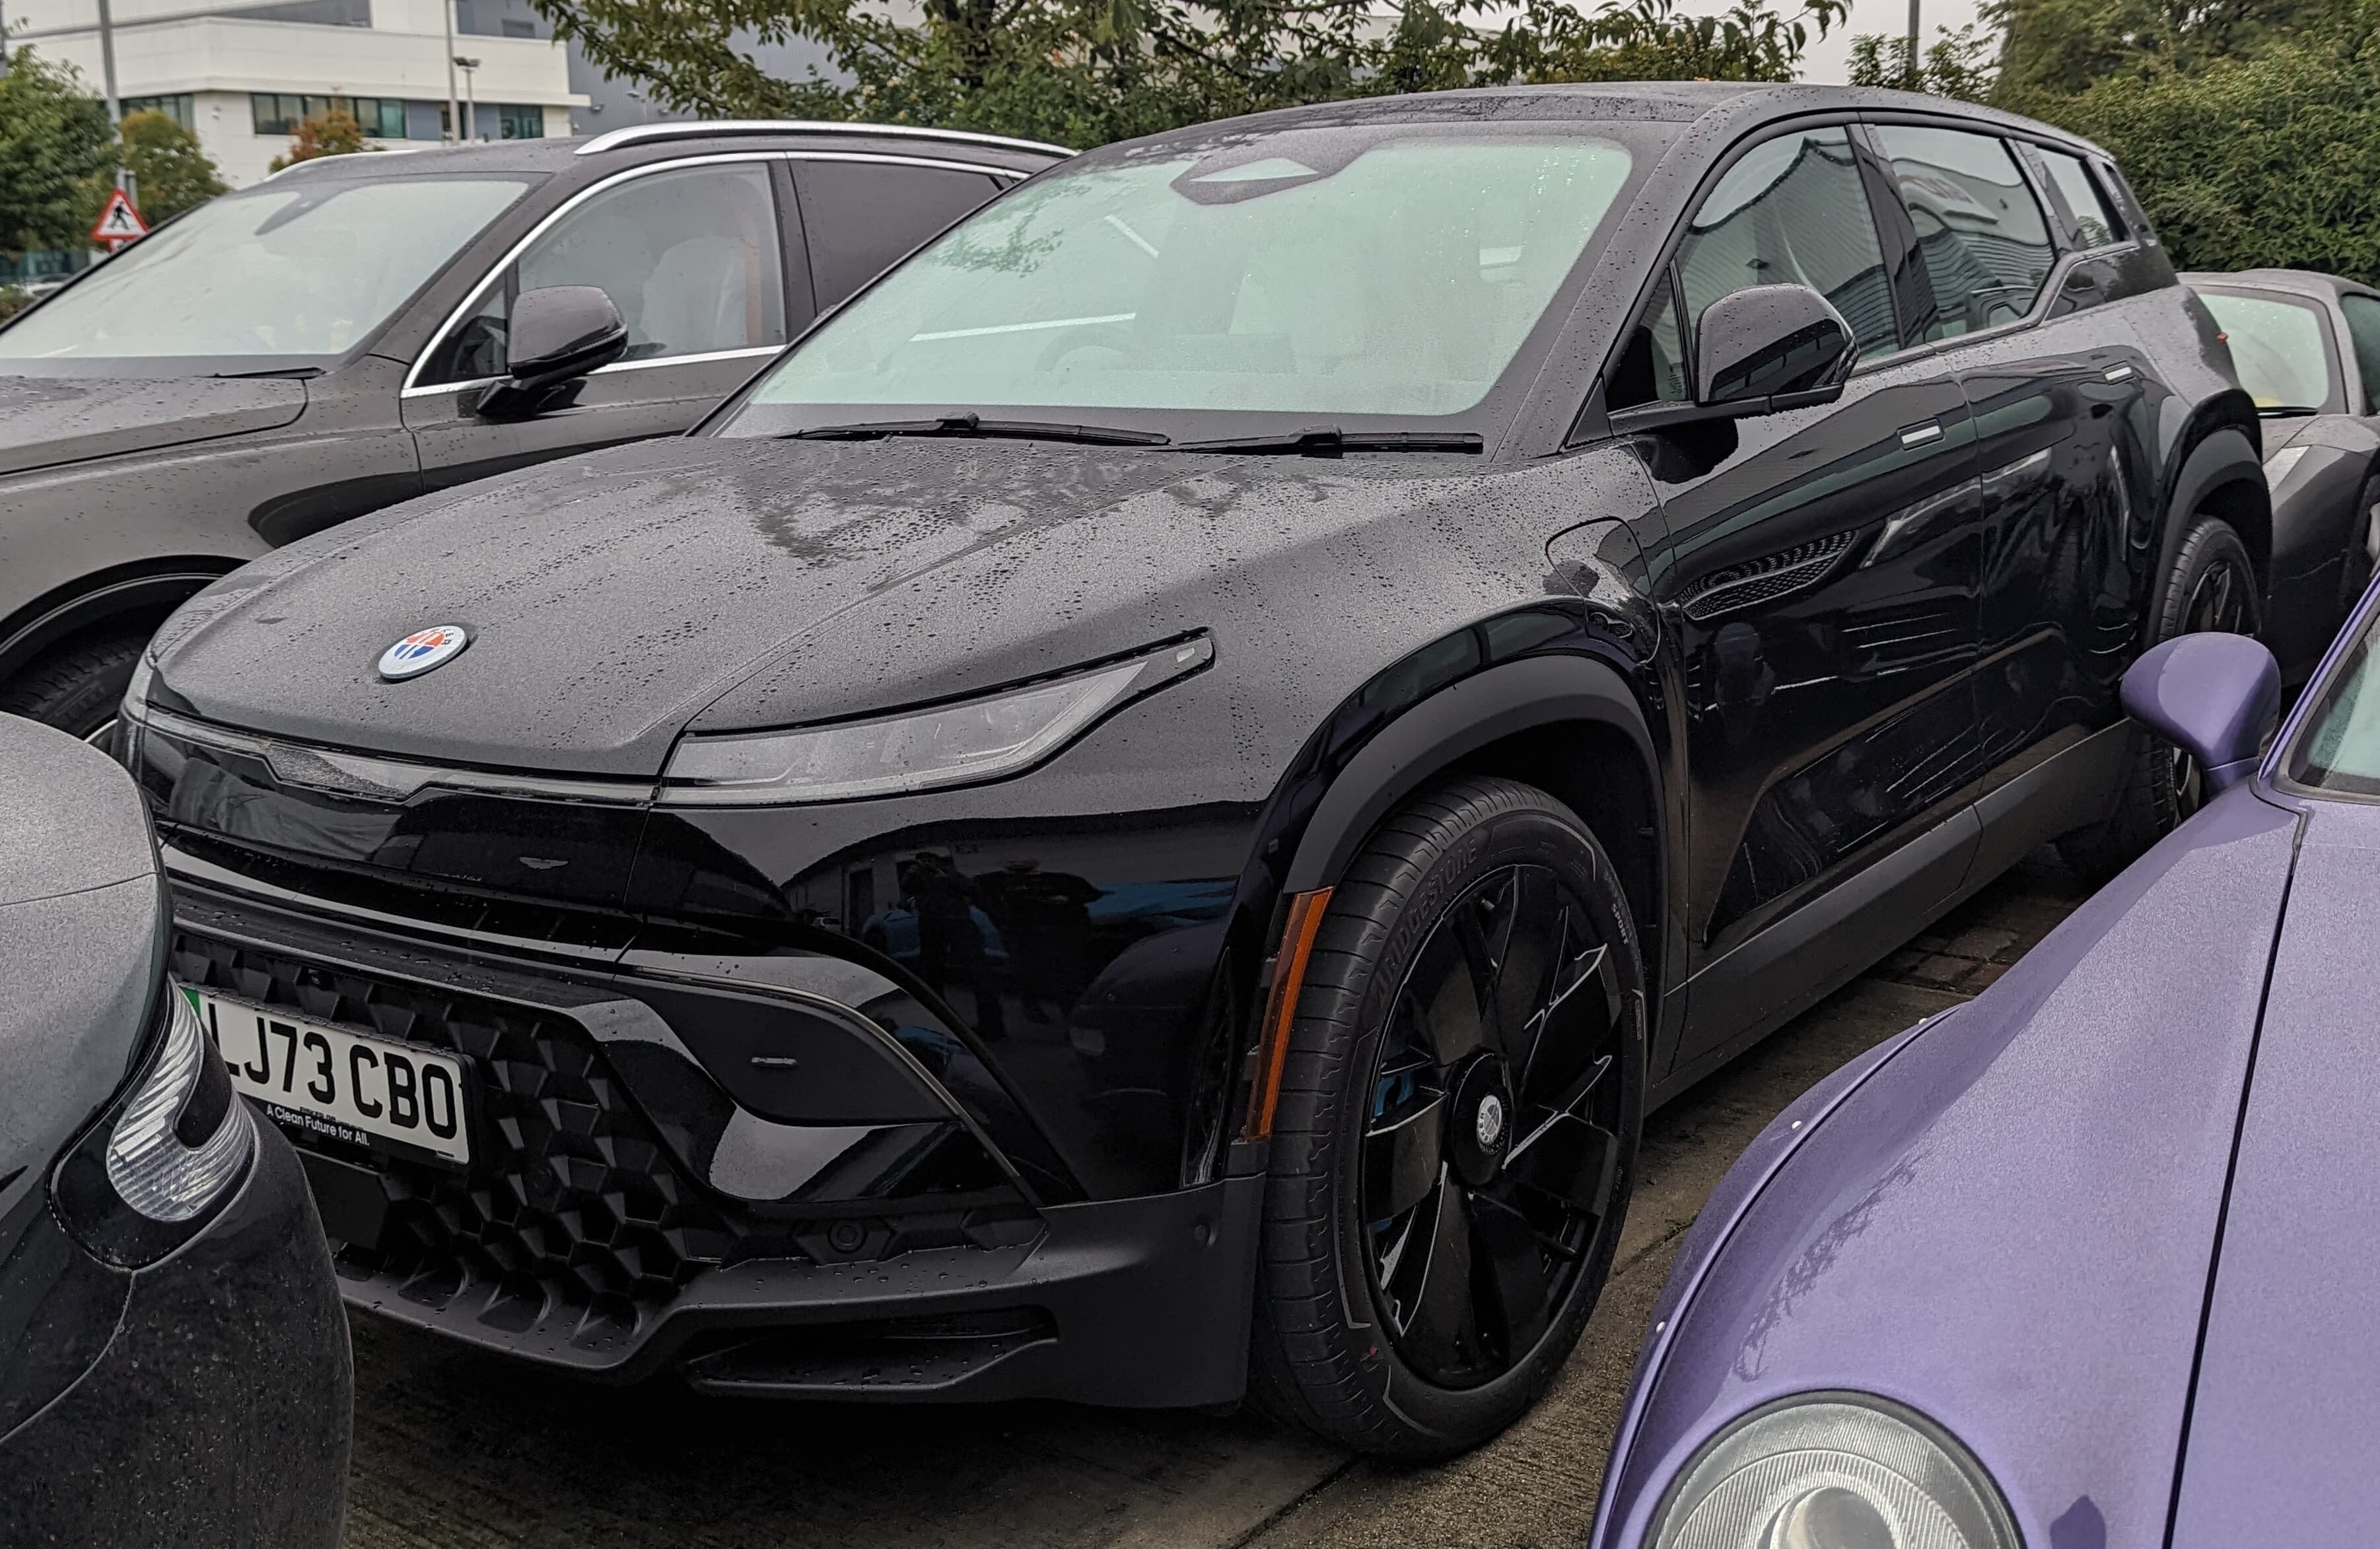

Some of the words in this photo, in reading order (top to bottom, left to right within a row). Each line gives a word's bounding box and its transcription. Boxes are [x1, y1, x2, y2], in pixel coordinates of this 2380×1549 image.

[1611, 902, 1629, 945] SPORT
[208, 1002, 336, 1104] LJ73
[349, 1044, 458, 1140] CBO
[266, 1104, 274, 1116] A
[275, 1106, 304, 1126] Clean
[305, 1115, 337, 1136] Future
[337, 1126, 353, 1141] for
[355, 1130, 370, 1146] All.
